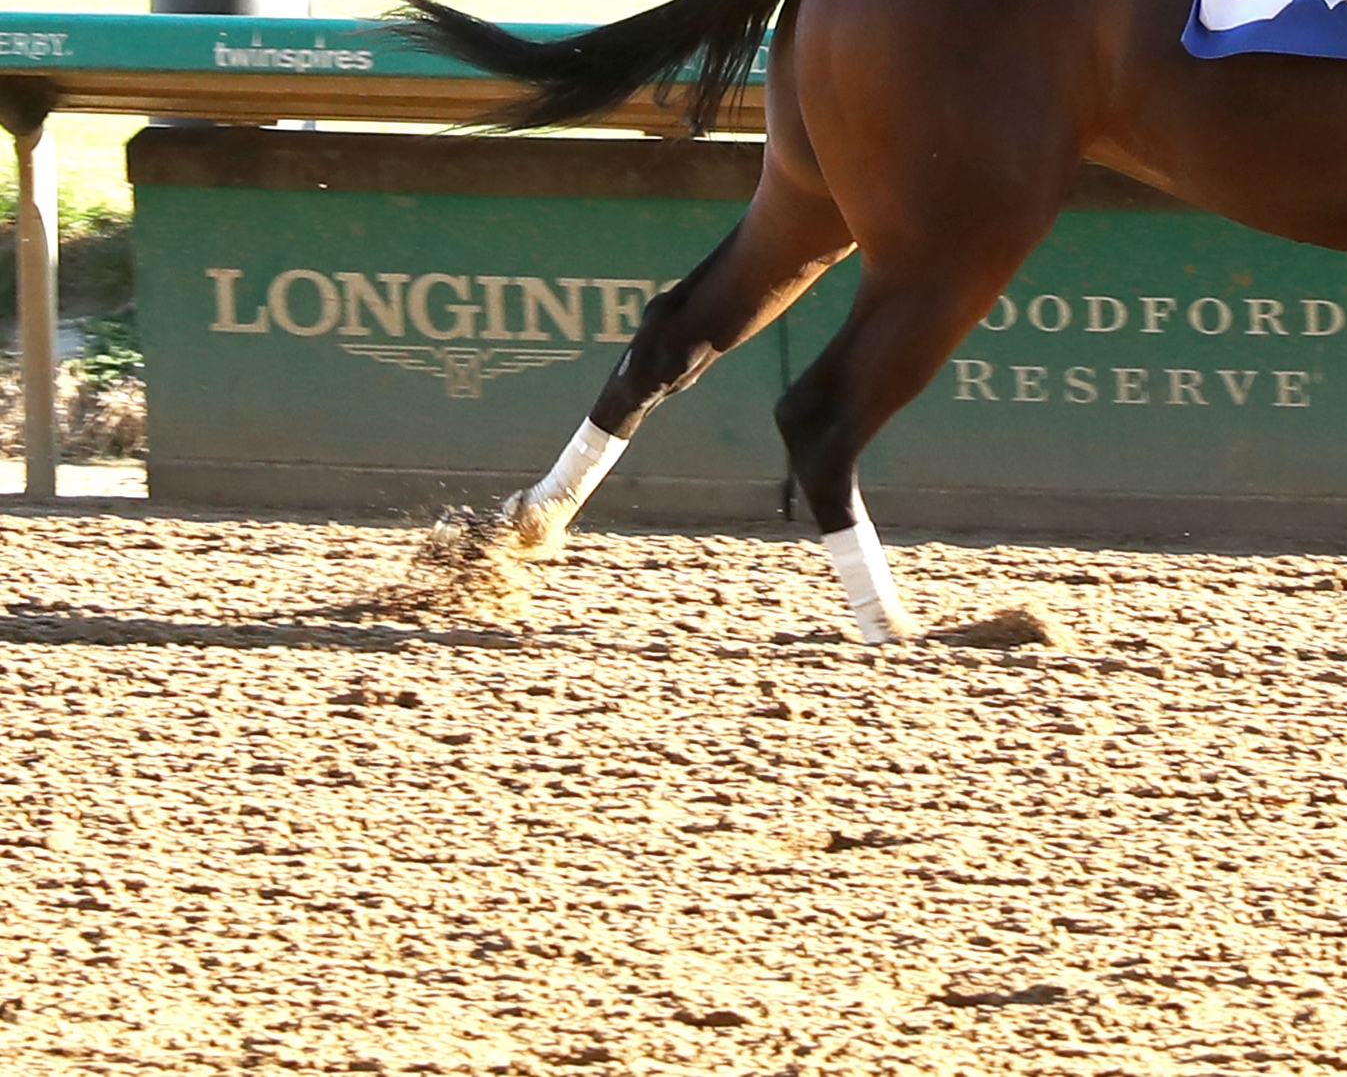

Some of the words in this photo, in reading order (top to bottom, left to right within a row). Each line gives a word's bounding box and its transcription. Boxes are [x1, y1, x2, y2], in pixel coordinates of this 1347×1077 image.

[213, 31, 374, 73] twinspires
[205, 267, 684, 343] LONGINE
[977, 293, 1347, 337] OODFORD
[952, 358, 1313, 408] RESERVE
